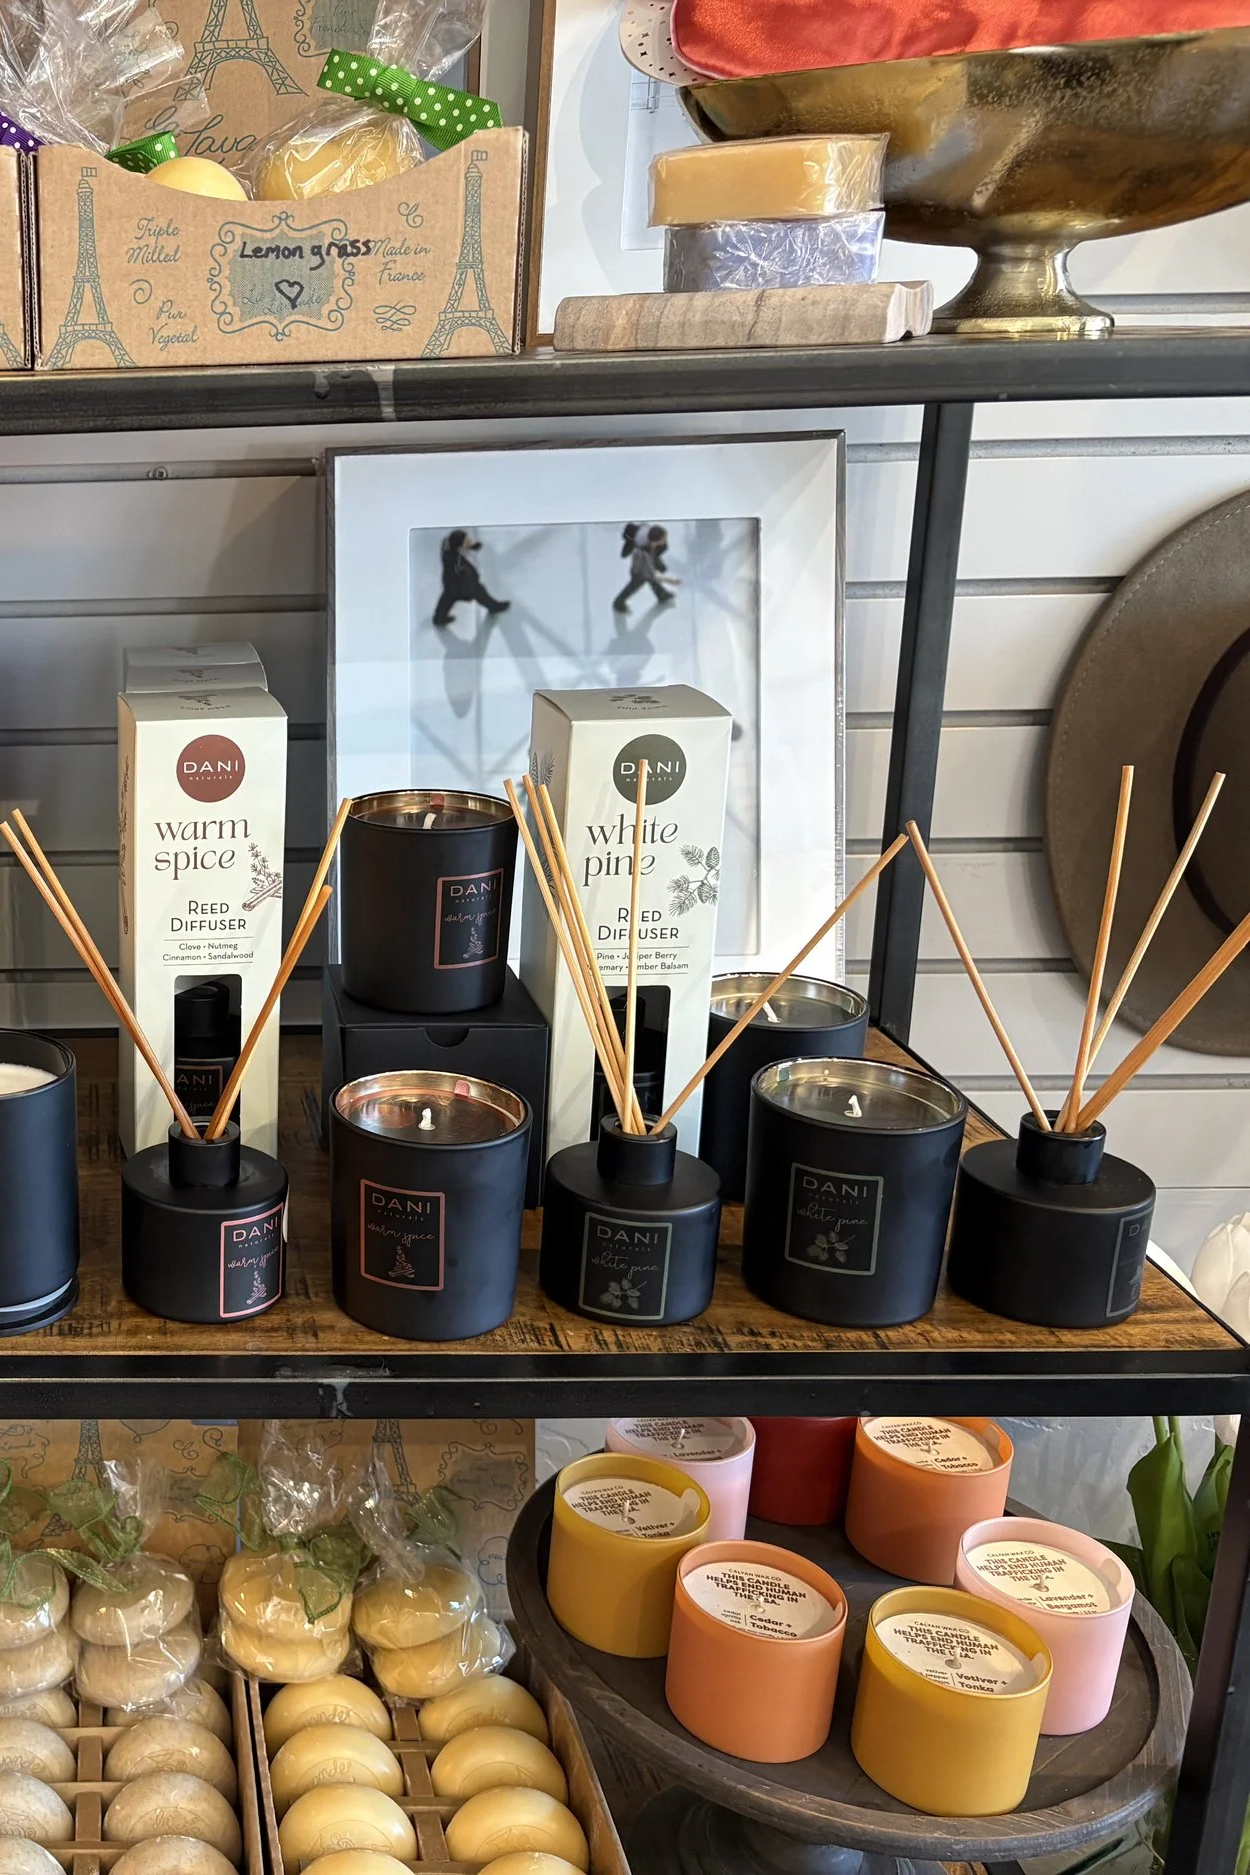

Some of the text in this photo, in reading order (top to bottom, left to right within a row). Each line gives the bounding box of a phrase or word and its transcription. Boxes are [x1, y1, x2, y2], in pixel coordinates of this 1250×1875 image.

[134, 217, 181, 244] Triple
[127, 244, 181, 265] Milled
[239, 238, 372, 272] Lemon grass
[370, 237, 431, 257] Made in
[378, 258, 426, 285] France
[156, 300, 187, 321] Pur
[149, 323, 200, 351] Vegetal
[183, 760, 239, 773] DANI
[154, 818, 251, 841] warm
[586, 813, 679, 846] white
[154, 846, 236, 880] spice
[582, 851, 656, 887] pine
[450, 878, 496, 896] DANI
[188, 900, 229, 915] REED
[617, 907, 662, 923] RED
[171, 917, 247, 933] DIFFUSER
[598, 925, 679, 941] DIFUSER
[178, 942, 238, 951] Clove Nutmeg
[162, 951, 254, 962] Cinnamon Sandalwood
[596, 951, 677, 961] Pine Juiper Berry
[636, 962, 689, 971] mber Balsam
[176, 1074, 212, 1085] ANI
[803, 1176, 867, 1198] DANI
[372, 1193, 430, 1214] DANI
[233, 1216, 278, 1242] DANI
[835, 1218, 869, 1232] pine
[597, 1225, 658, 1244] DANI
[627, 1265, 659, 1280] pine
[900, 1425, 935, 1433] CANDLE
[919, 1428, 952, 1436] HUMAN
[940, 1462, 979, 1470] Tobacco
[571, 1501, 599, 1509] HELPS
[618, 1491, 651, 1501] HUMAN
[579, 1488, 635, 1502] THIS CANDLE
[582, 1501, 639, 1513] TRAFFICKNG
[976, 1564, 1007, 1572] HELPS
[1029, 1558, 1067, 1569] HUMAN
[1008, 1554, 1048, 1564] CANDLE
[988, 1567, 1053, 1577] TRAFFICKING
[706, 1574, 807, 1599] HELPS END HUMAN
[721, 1572, 790, 1590] THIS CANDLE
[714, 1581, 785, 1600] TRAFFICKING
[733, 1591, 755, 1601] THE
[1038, 1594, 1087, 1602] Lavender
[1046, 1601, 1098, 1610] Bergamot
[749, 1614, 784, 1627] Cedar
[750, 1621, 798, 1637] Tobacco
[907, 1625, 981, 1642] THIS CANDLE
[893, 1628, 999, 1650] HELPS END HUMAN
[903, 1635, 977, 1654] TRAFFICKNG
[924, 1646, 947, 1656] THE
[955, 1672, 999, 1685] Vetiver
[958, 1681, 995, 1693] Tonka
